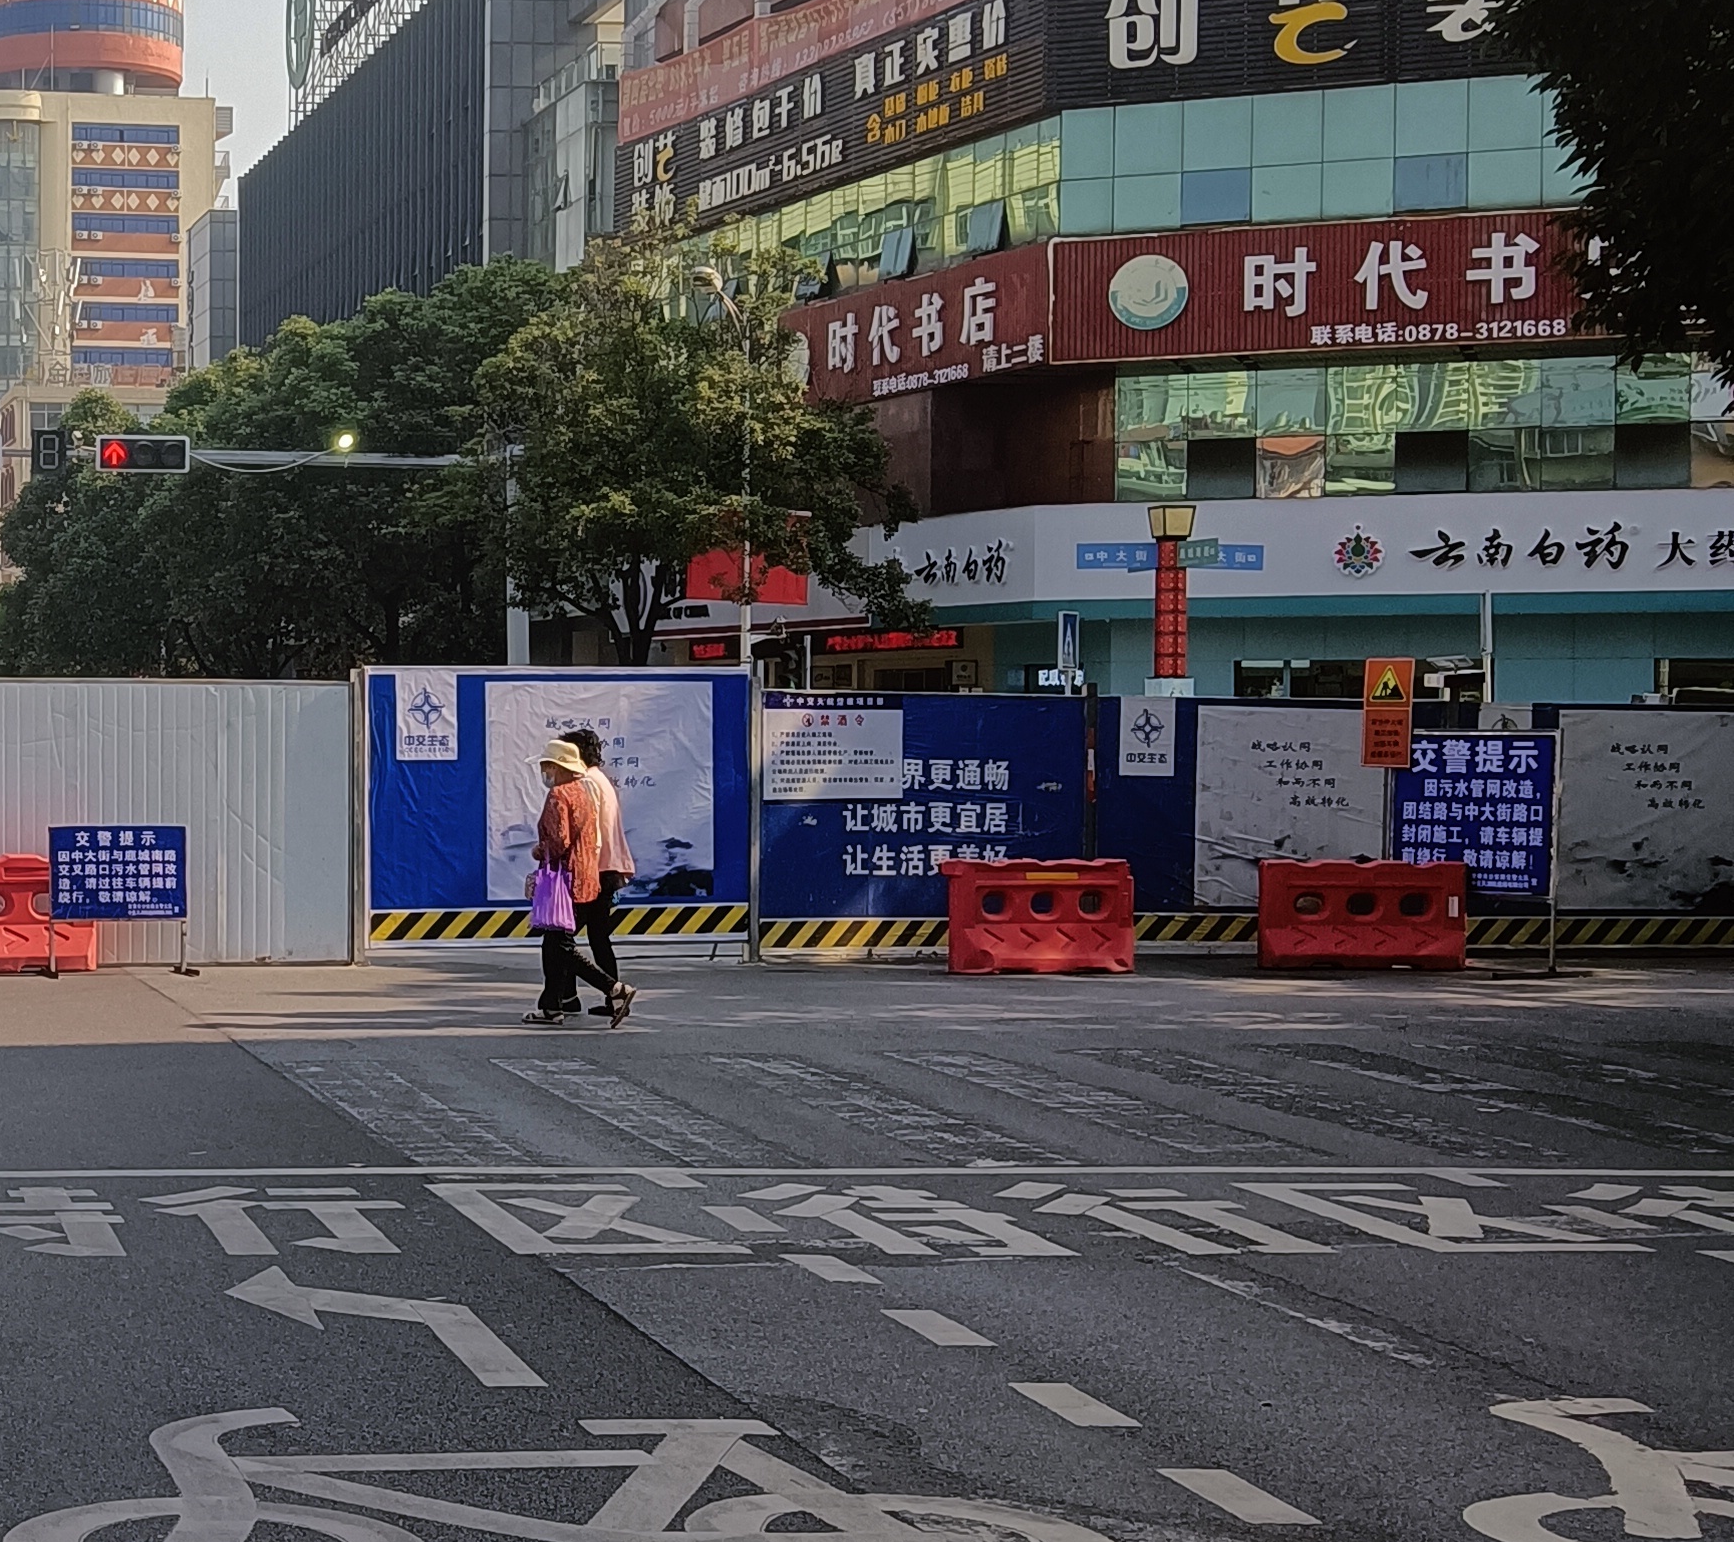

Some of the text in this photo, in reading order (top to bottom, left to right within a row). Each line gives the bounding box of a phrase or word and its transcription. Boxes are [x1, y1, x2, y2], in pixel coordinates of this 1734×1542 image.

[698, 73, 822, 160] 装修包干价
[867, 113, 882, 143] 含
[633, 128, 677, 187] 创艺
[1242, 232, 1606, 317] 时代书
[827, 276, 997, 374] 时代书店
[982, 334, 1045, 373] 请上二楼
[1409, 521, 1630, 571] 云南白药
[914, 537, 1009, 585] 云南白药
[546, 718, 610, 730] 战略认同
[404, 735, 450, 747] 中交生态
[1126, 753, 1168, 764] 中交生态
[1411, 740, 1539, 774] 交警提示
[1424, 778, 1542, 800] 因污水管网改造，
[843, 801, 1009, 833] 让城市更宜居
[1402, 801, 1543, 823] 团结路与中大街路口
[75, 831, 157, 846] 交警提示
[1401, 825, 1543, 847] 封闭施工，请车辆提
[57, 850, 176, 862] 因中大街与鹿城南路
[1401, 847, 1534, 871] 前绕行敬请谅解！
[58, 863, 177, 875] 交叉路口污水管网改
[58, 877, 177, 889] 造，请过往车辆提前
[58, 891, 158, 903] 绕行，敬请谅解。
